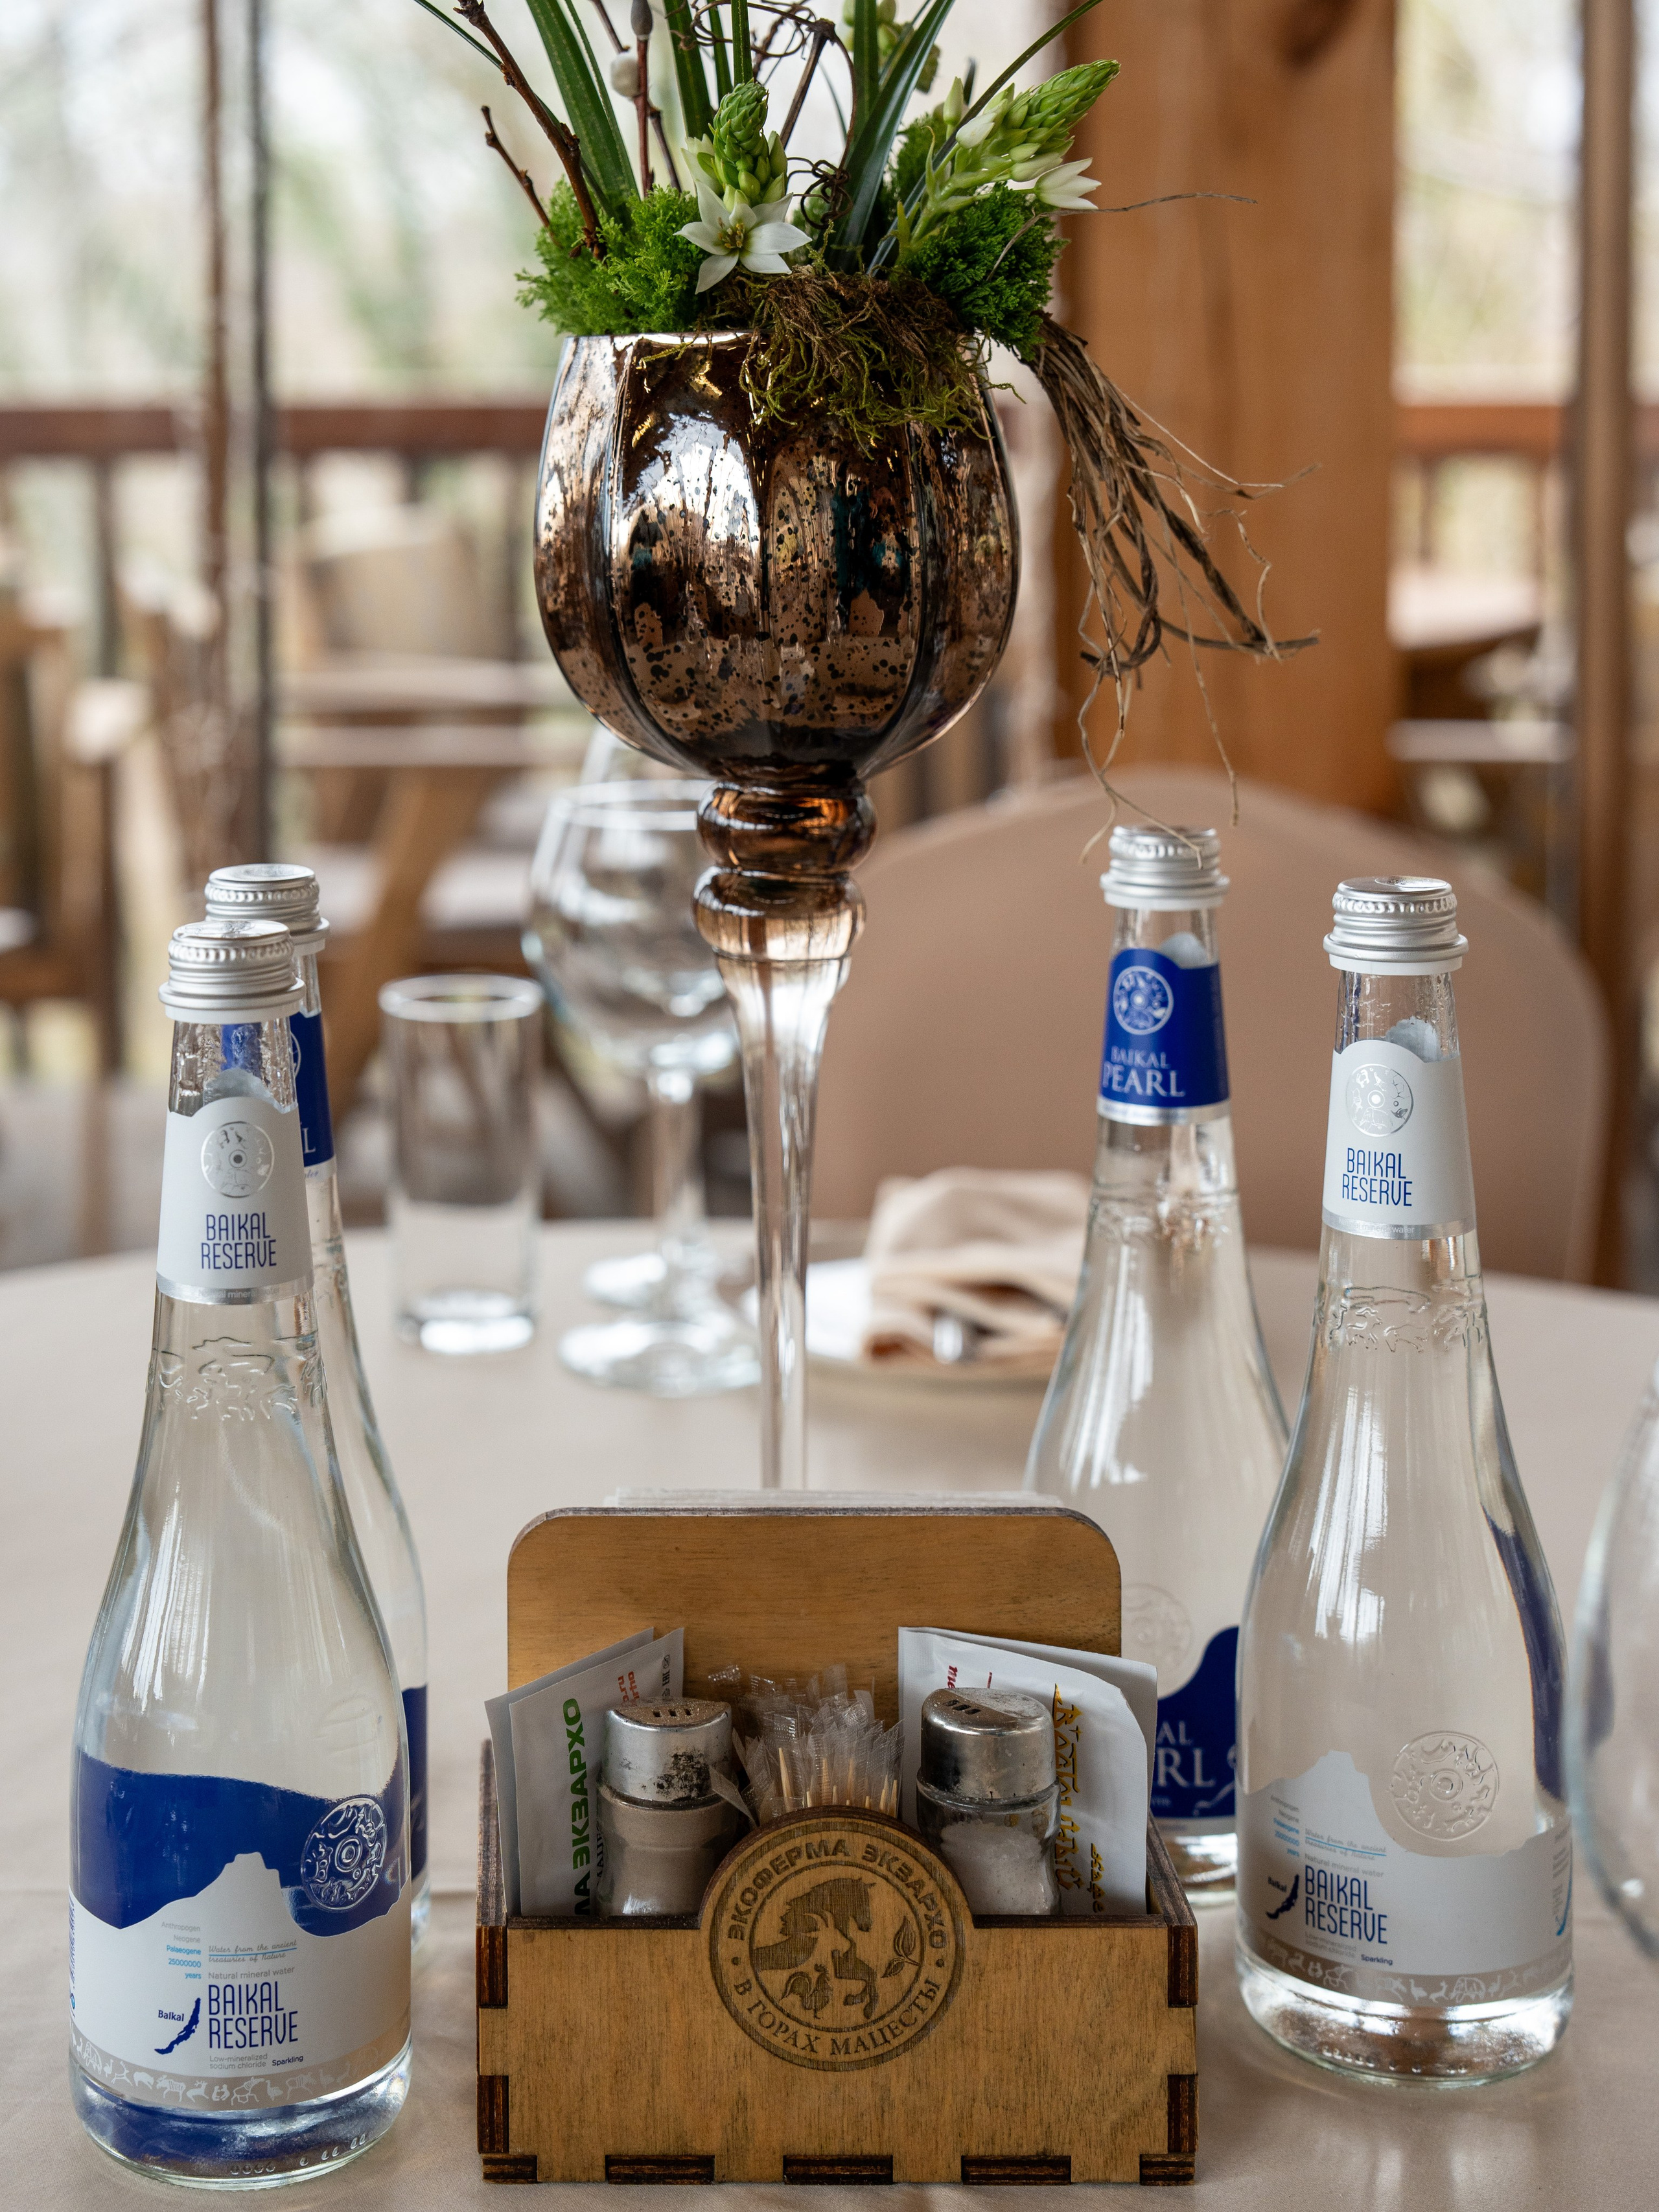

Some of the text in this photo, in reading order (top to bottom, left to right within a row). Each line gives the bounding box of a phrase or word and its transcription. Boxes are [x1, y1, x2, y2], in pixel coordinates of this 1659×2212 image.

[1110, 1045, 1171, 1069] BAIKAL
[1102, 1060, 1186, 1097] PEARL
[1347, 1147, 1406, 1179] BAIKAL
[1342, 1173, 1413, 1207] RESERVE
[206, 1212, 271, 1241] BAIKAL
[201, 1239, 277, 1270] RESERVE
[563, 1697, 590, 1870] ЭКЗАРХО
[1331, 1861, 1360, 1874] mineral
[1362, 1869, 1384, 1878] water
[728, 1839, 850, 1940] ЭКОФЕРМА
[862, 1844, 947, 1949] ЭКЗАРХО
[1305, 1865, 1373, 1911] BAIKAL
[161, 1922, 200, 1932] Anthropogen
[1305, 1896, 1387, 1944] RESERVE
[167, 1944, 202, 1955] Palaeogene
[173, 1935, 200, 1943] Neogene
[272, 1939, 297, 1949] ancient
[249, 1955, 258, 1963] of
[1361, 1954, 1393, 1966] Sparkling
[209, 1966, 295, 1980] Natural mineral water
[209, 1981, 284, 2016] BAIKAL
[158, 2010, 185, 2021] Baikal
[733, 1979, 942, 2056] В ГОРАХ МАЦЕСТЫ
[209, 2010, 298, 2049] RESERVE
[209, 2053, 268, 2062] Low-mineralized
[238, 2060, 266, 2069] chloride
[272, 2056, 303, 2067] Sparkling
